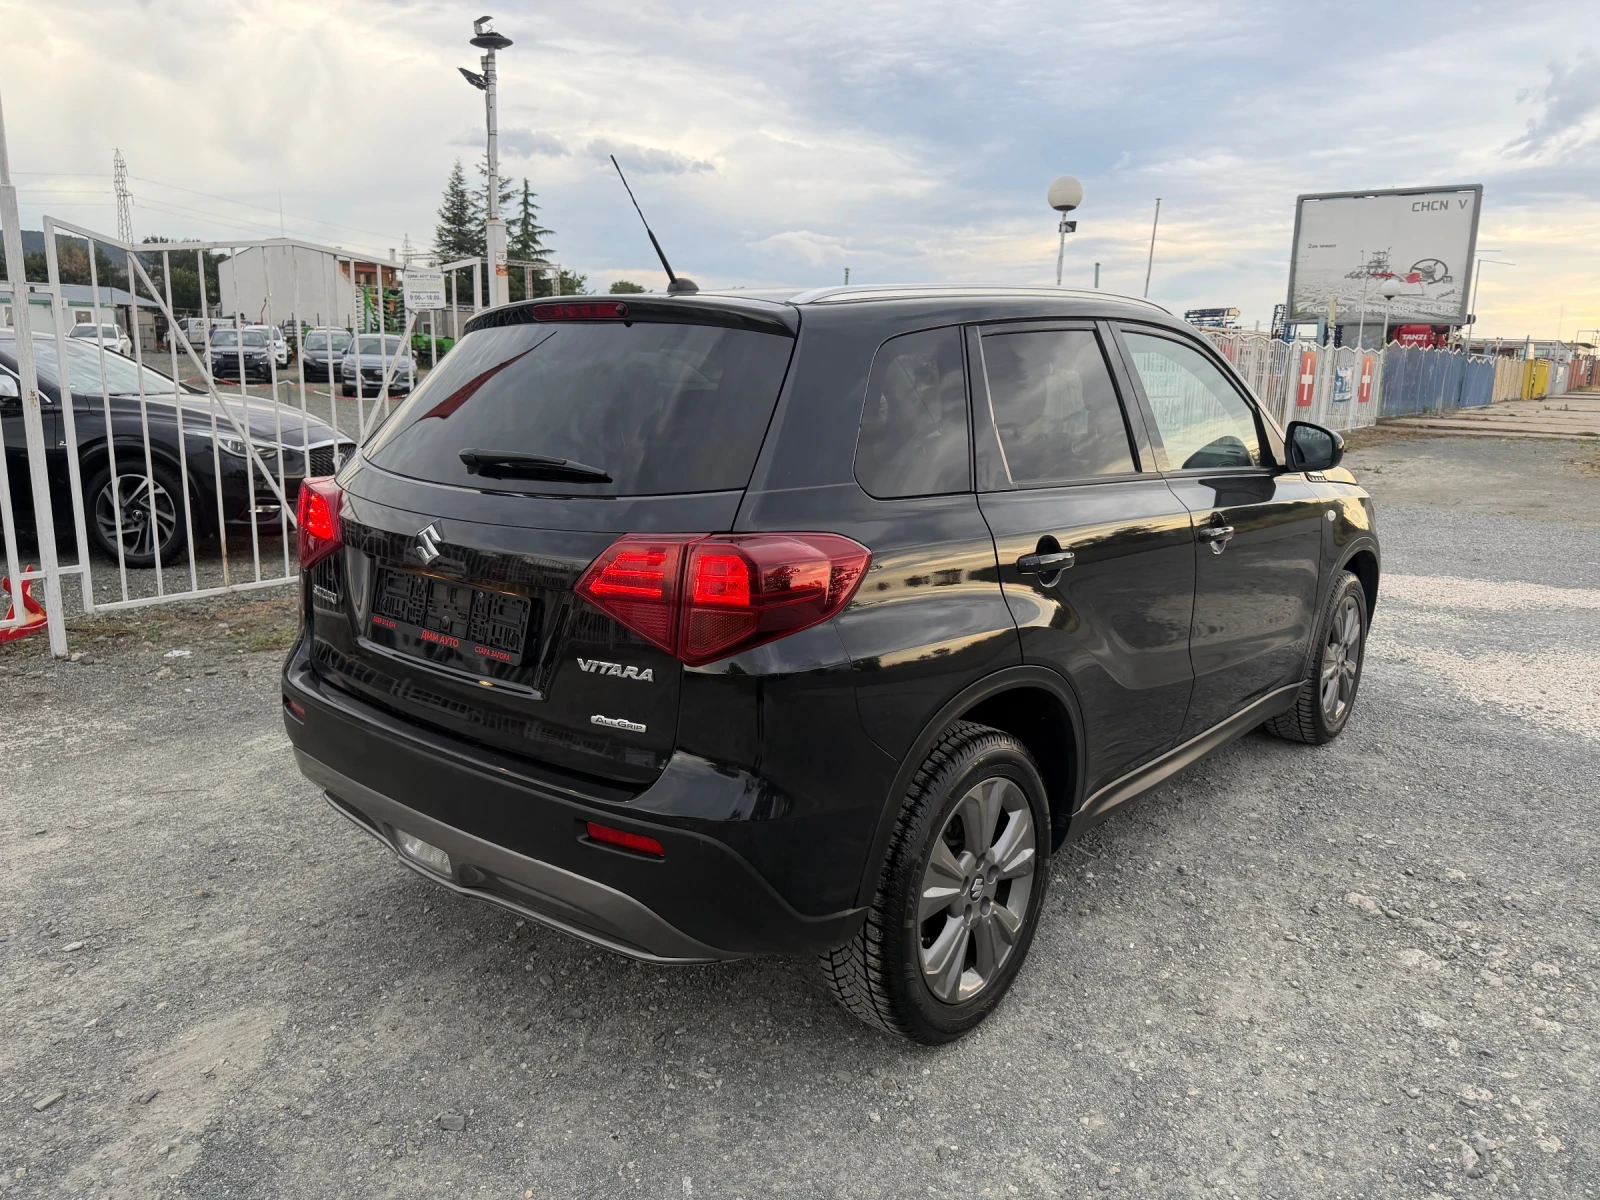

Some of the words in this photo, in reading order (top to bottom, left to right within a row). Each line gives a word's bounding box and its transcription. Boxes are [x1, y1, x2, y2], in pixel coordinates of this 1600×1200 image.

[1411, 200, 1449, 213] CHCN
[1401, 333, 1427, 341] TANZI
[420, 629, 439, 643] ДММ
[439, 635, 459, 648] АУТО
[474, 645, 490, 657] СТАРА
[577, 657, 654, 682] VITARA
